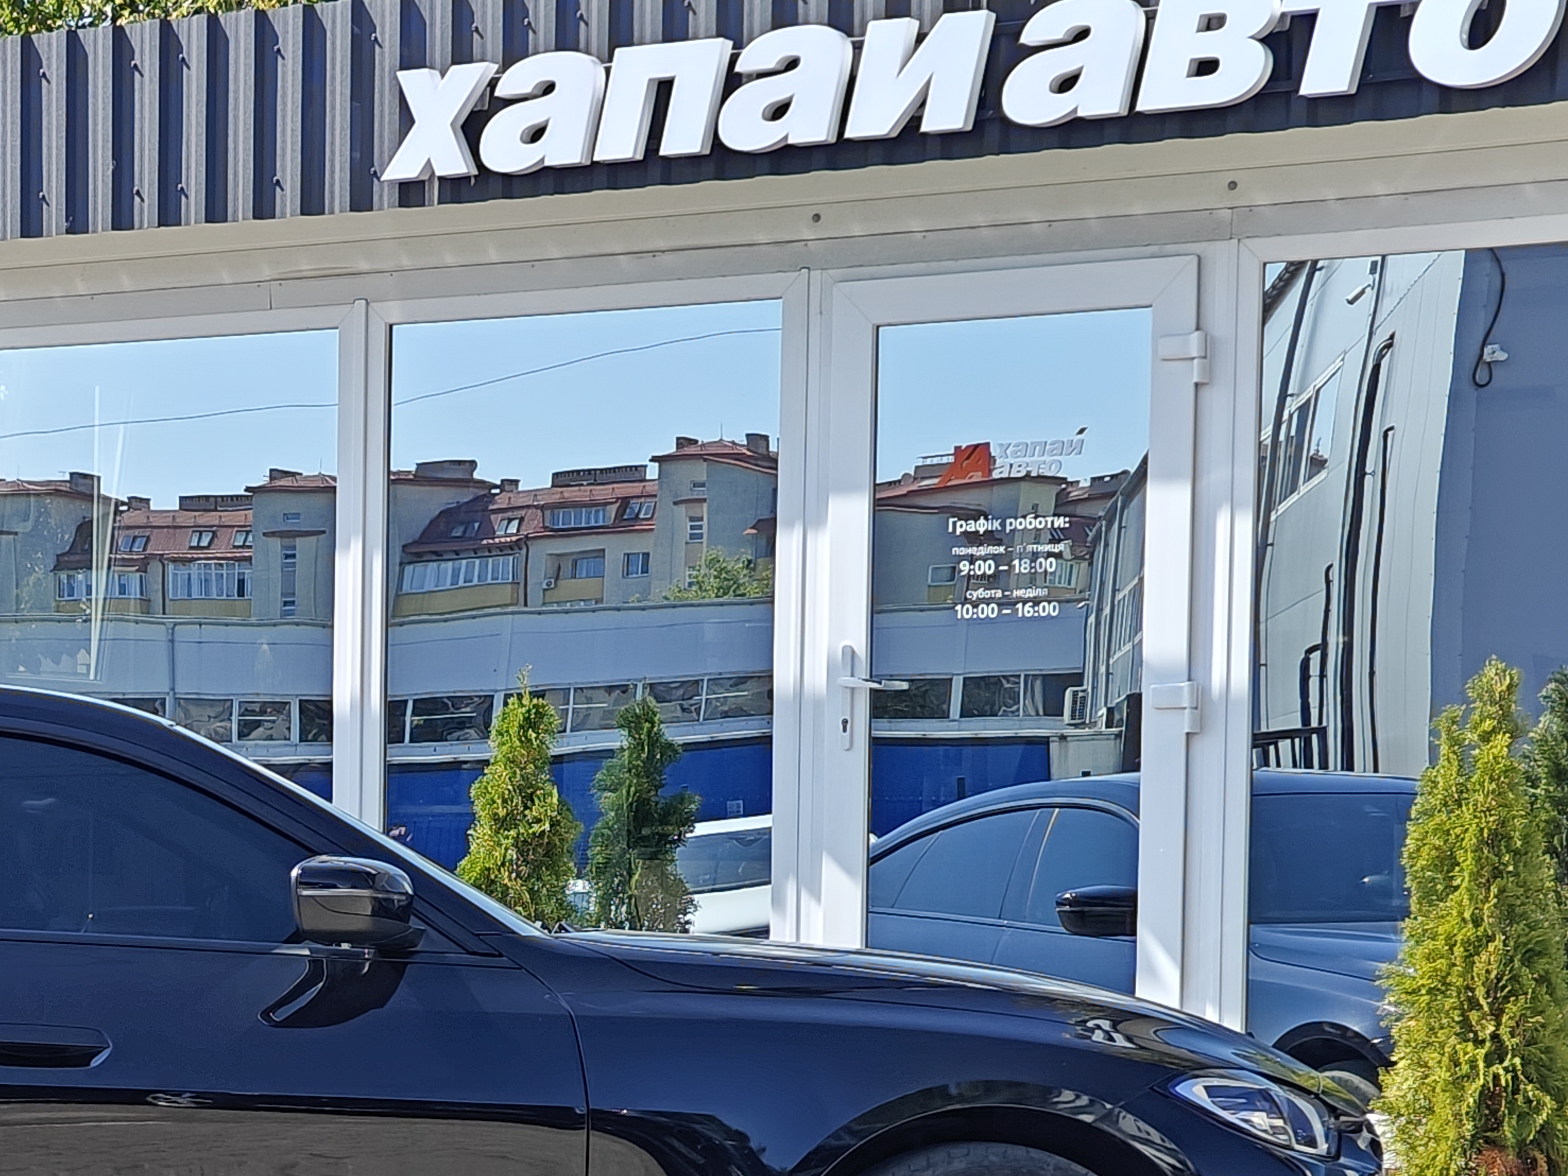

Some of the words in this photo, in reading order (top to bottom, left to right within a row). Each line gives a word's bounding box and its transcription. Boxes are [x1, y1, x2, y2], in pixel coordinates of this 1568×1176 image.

[1001, 0, 1566, 127] авто
[996, 427, 1088, 459] хапай
[992, 459, 1063, 478] авто
[948, 515, 1001, 535] Графік
[1005, 514, 1070, 533] роботи:
[959, 560, 995, 576] 9:00
[1012, 558, 1057, 574] 18:00
[966, 588, 1003, 600] субота
[1013, 586, 1048, 598] неділя
[954, 603, 998, 619] 10:00
[1015, 602, 1059, 618] 16:00
